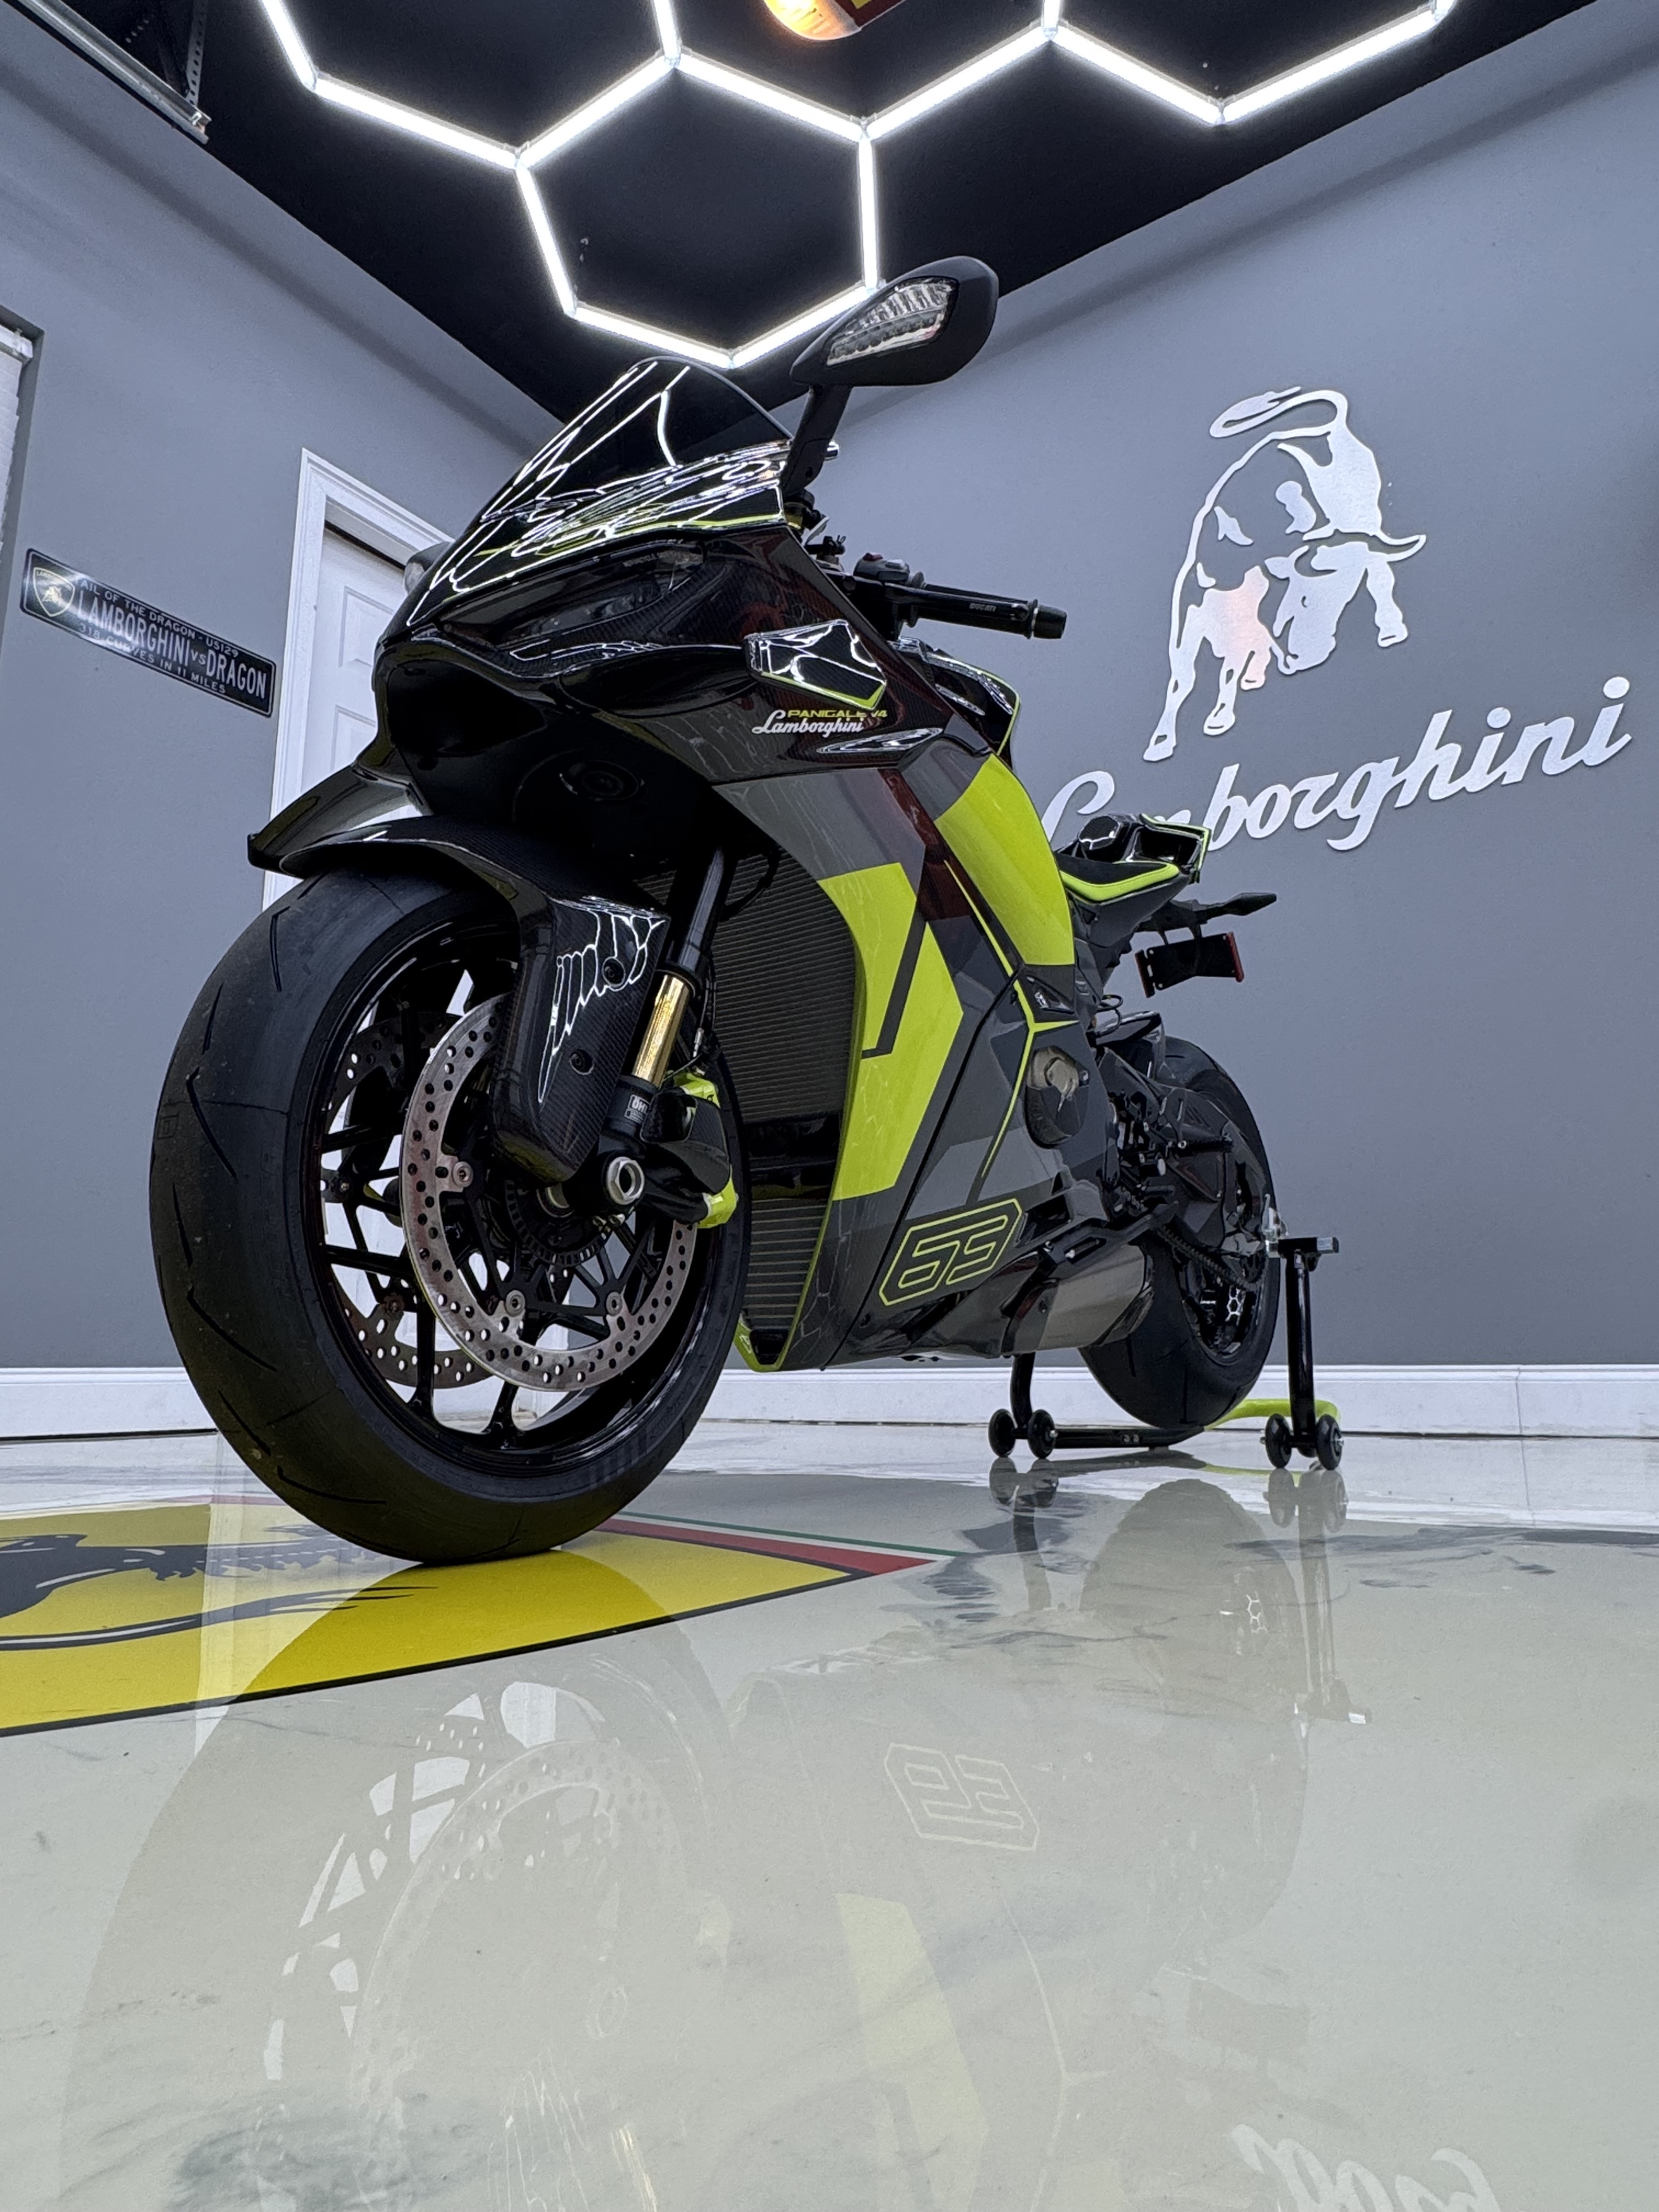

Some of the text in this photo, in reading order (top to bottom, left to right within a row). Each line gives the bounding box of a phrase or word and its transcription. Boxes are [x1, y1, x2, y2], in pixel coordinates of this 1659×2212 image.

[77, 590, 190, 667] LAMBORGHINI
[206, 649, 267, 699] DRAGON
[79, 623, 100, 639] 318
[160, 659, 172, 671] IN
[178, 667, 187, 677] 11
[191, 672, 226, 693] MILES
[104, 591, 120, 602] OF
[125, 599, 146, 616] THE
[149, 612, 195, 640] DRAGON
[206, 637, 239, 658] US129
[752, 709, 864, 738] Lamborghini
[879, 1198, 1023, 1306] 63
